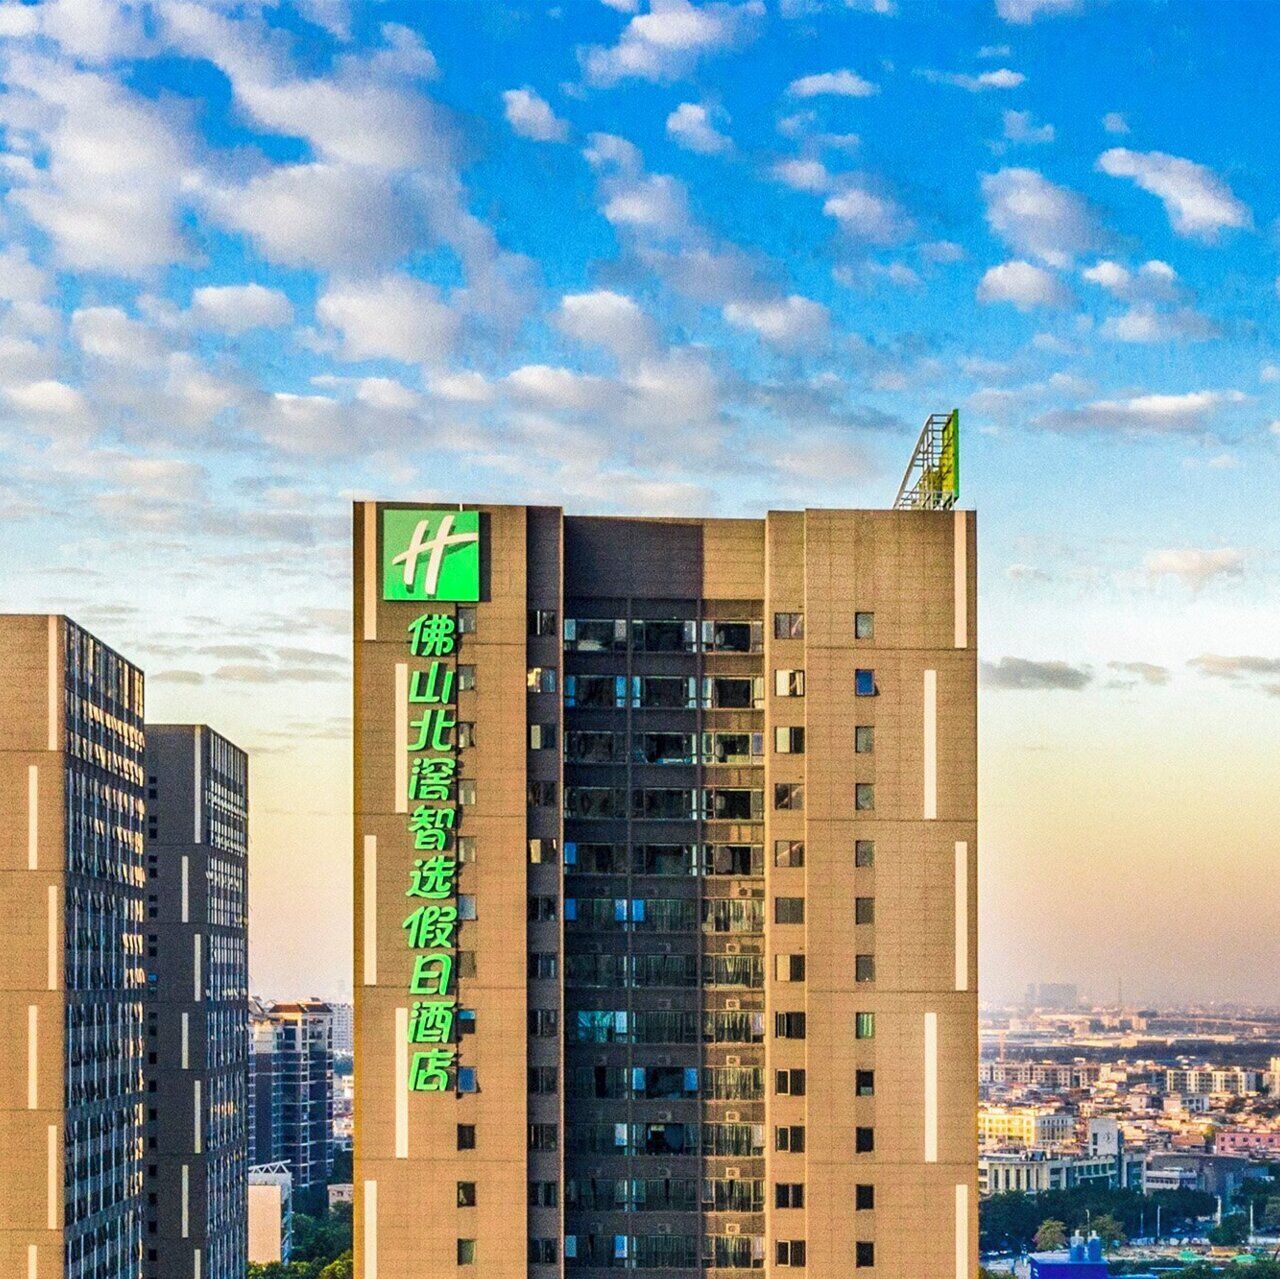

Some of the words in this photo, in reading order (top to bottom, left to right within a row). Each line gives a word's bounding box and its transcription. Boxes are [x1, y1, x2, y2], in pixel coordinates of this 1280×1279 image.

[402, 612, 456, 1092] 佛山北滘智选假日酒店
